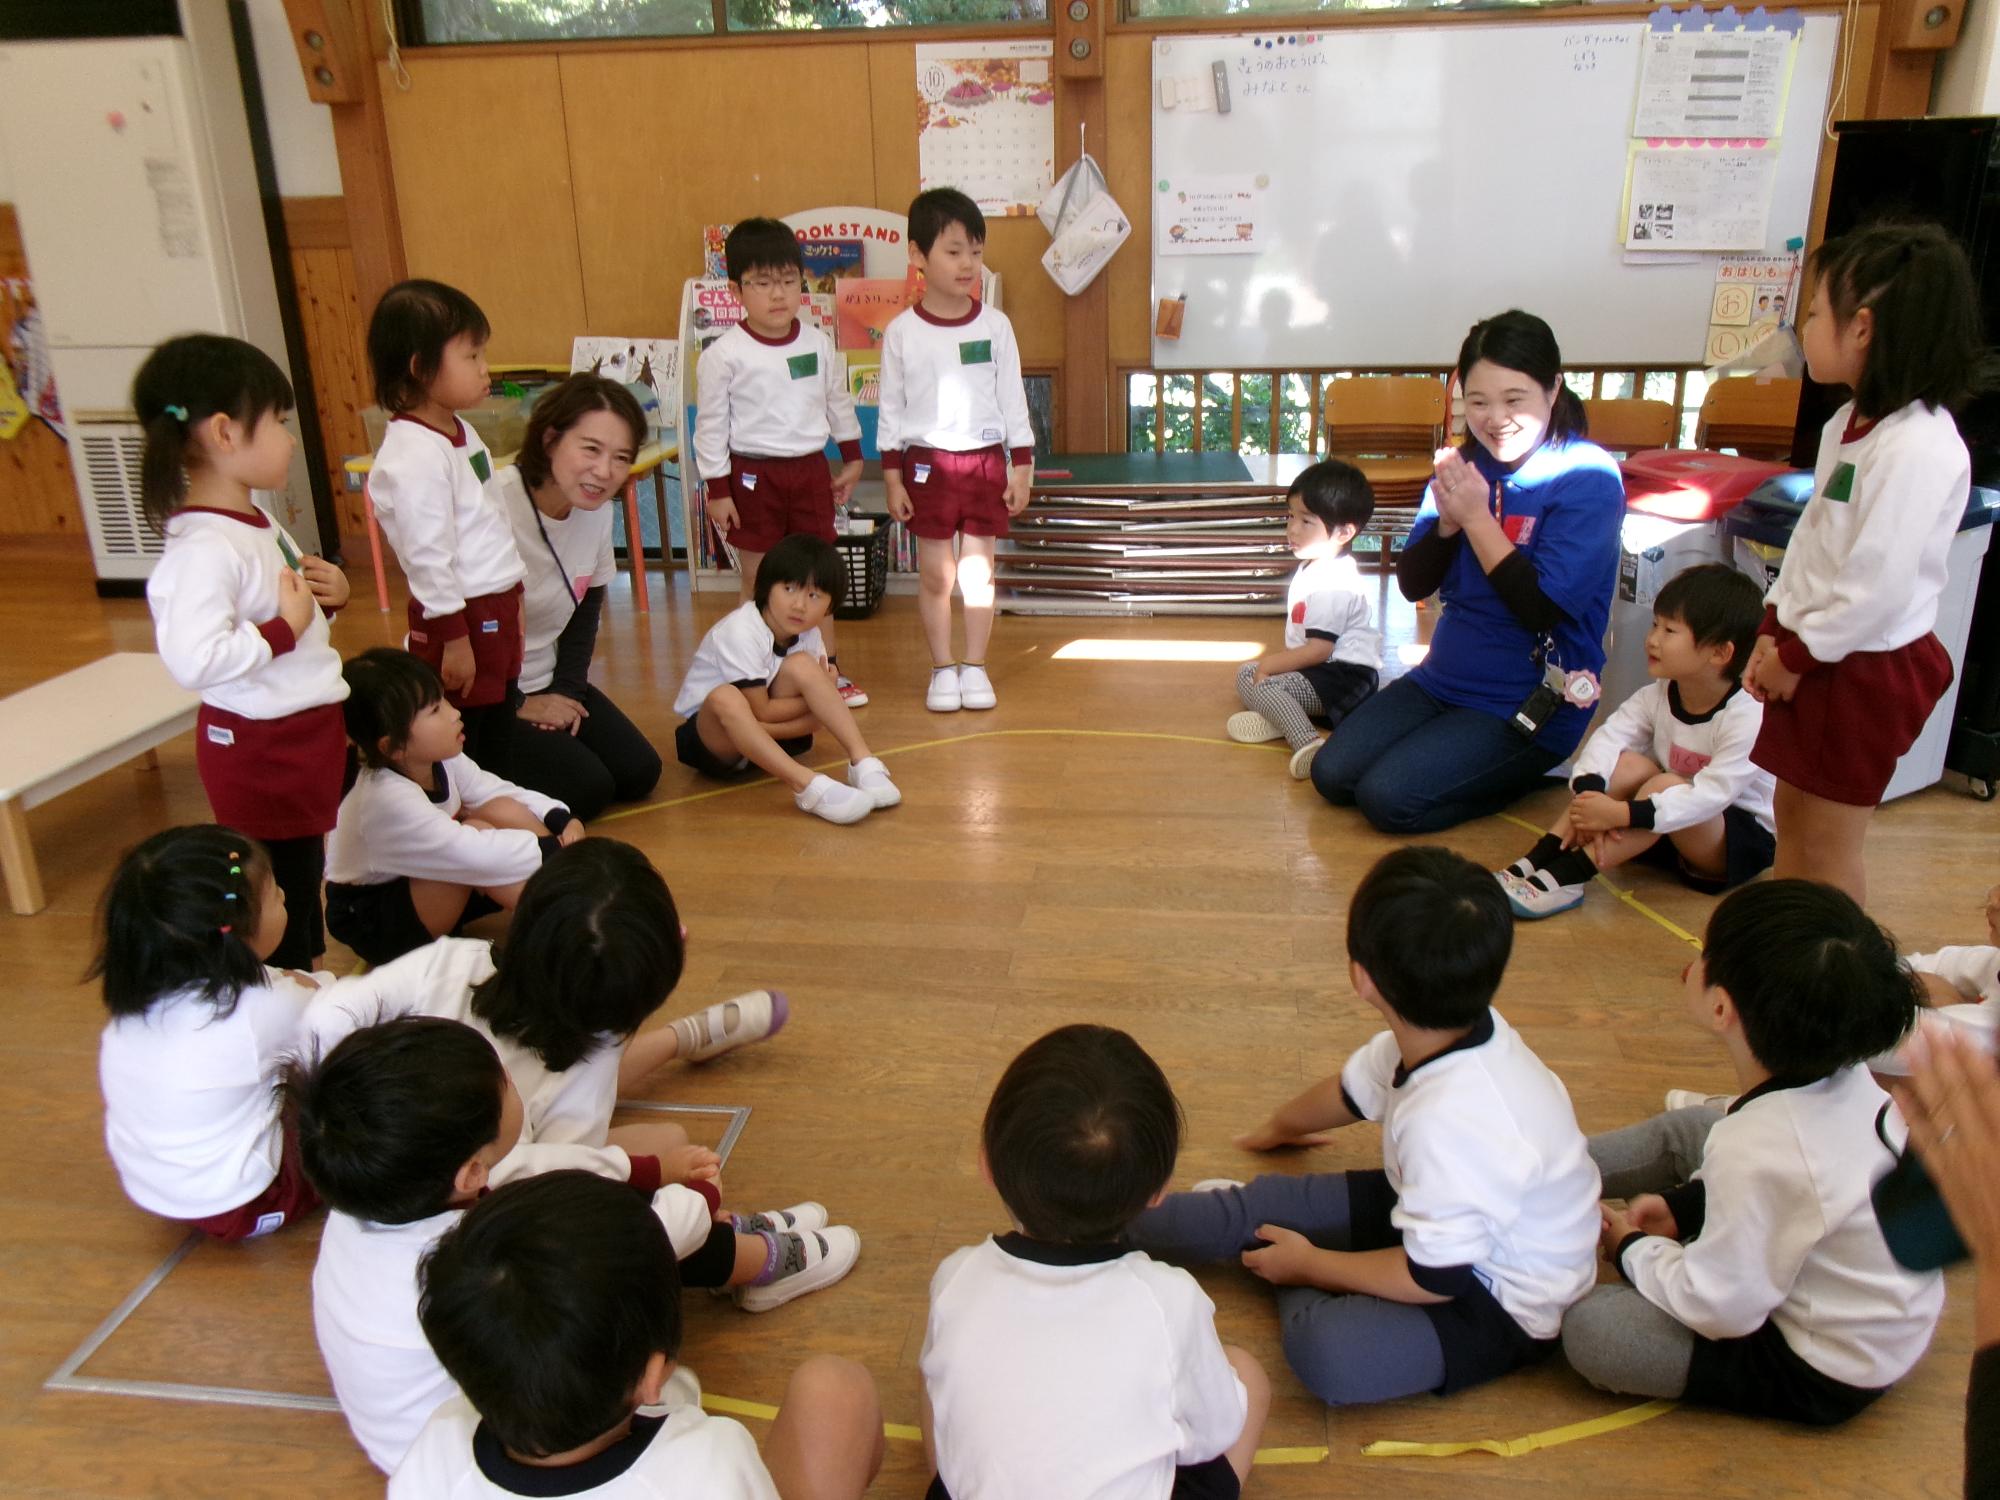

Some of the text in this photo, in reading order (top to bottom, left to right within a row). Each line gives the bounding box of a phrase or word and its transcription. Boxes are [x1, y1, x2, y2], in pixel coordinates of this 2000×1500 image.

[927, 70, 942, 88] 10
[795, 223, 900, 244] OOK STAND
[1721, 266, 1777, 278] おはしも
[1721, 294, 1740, 315] お
